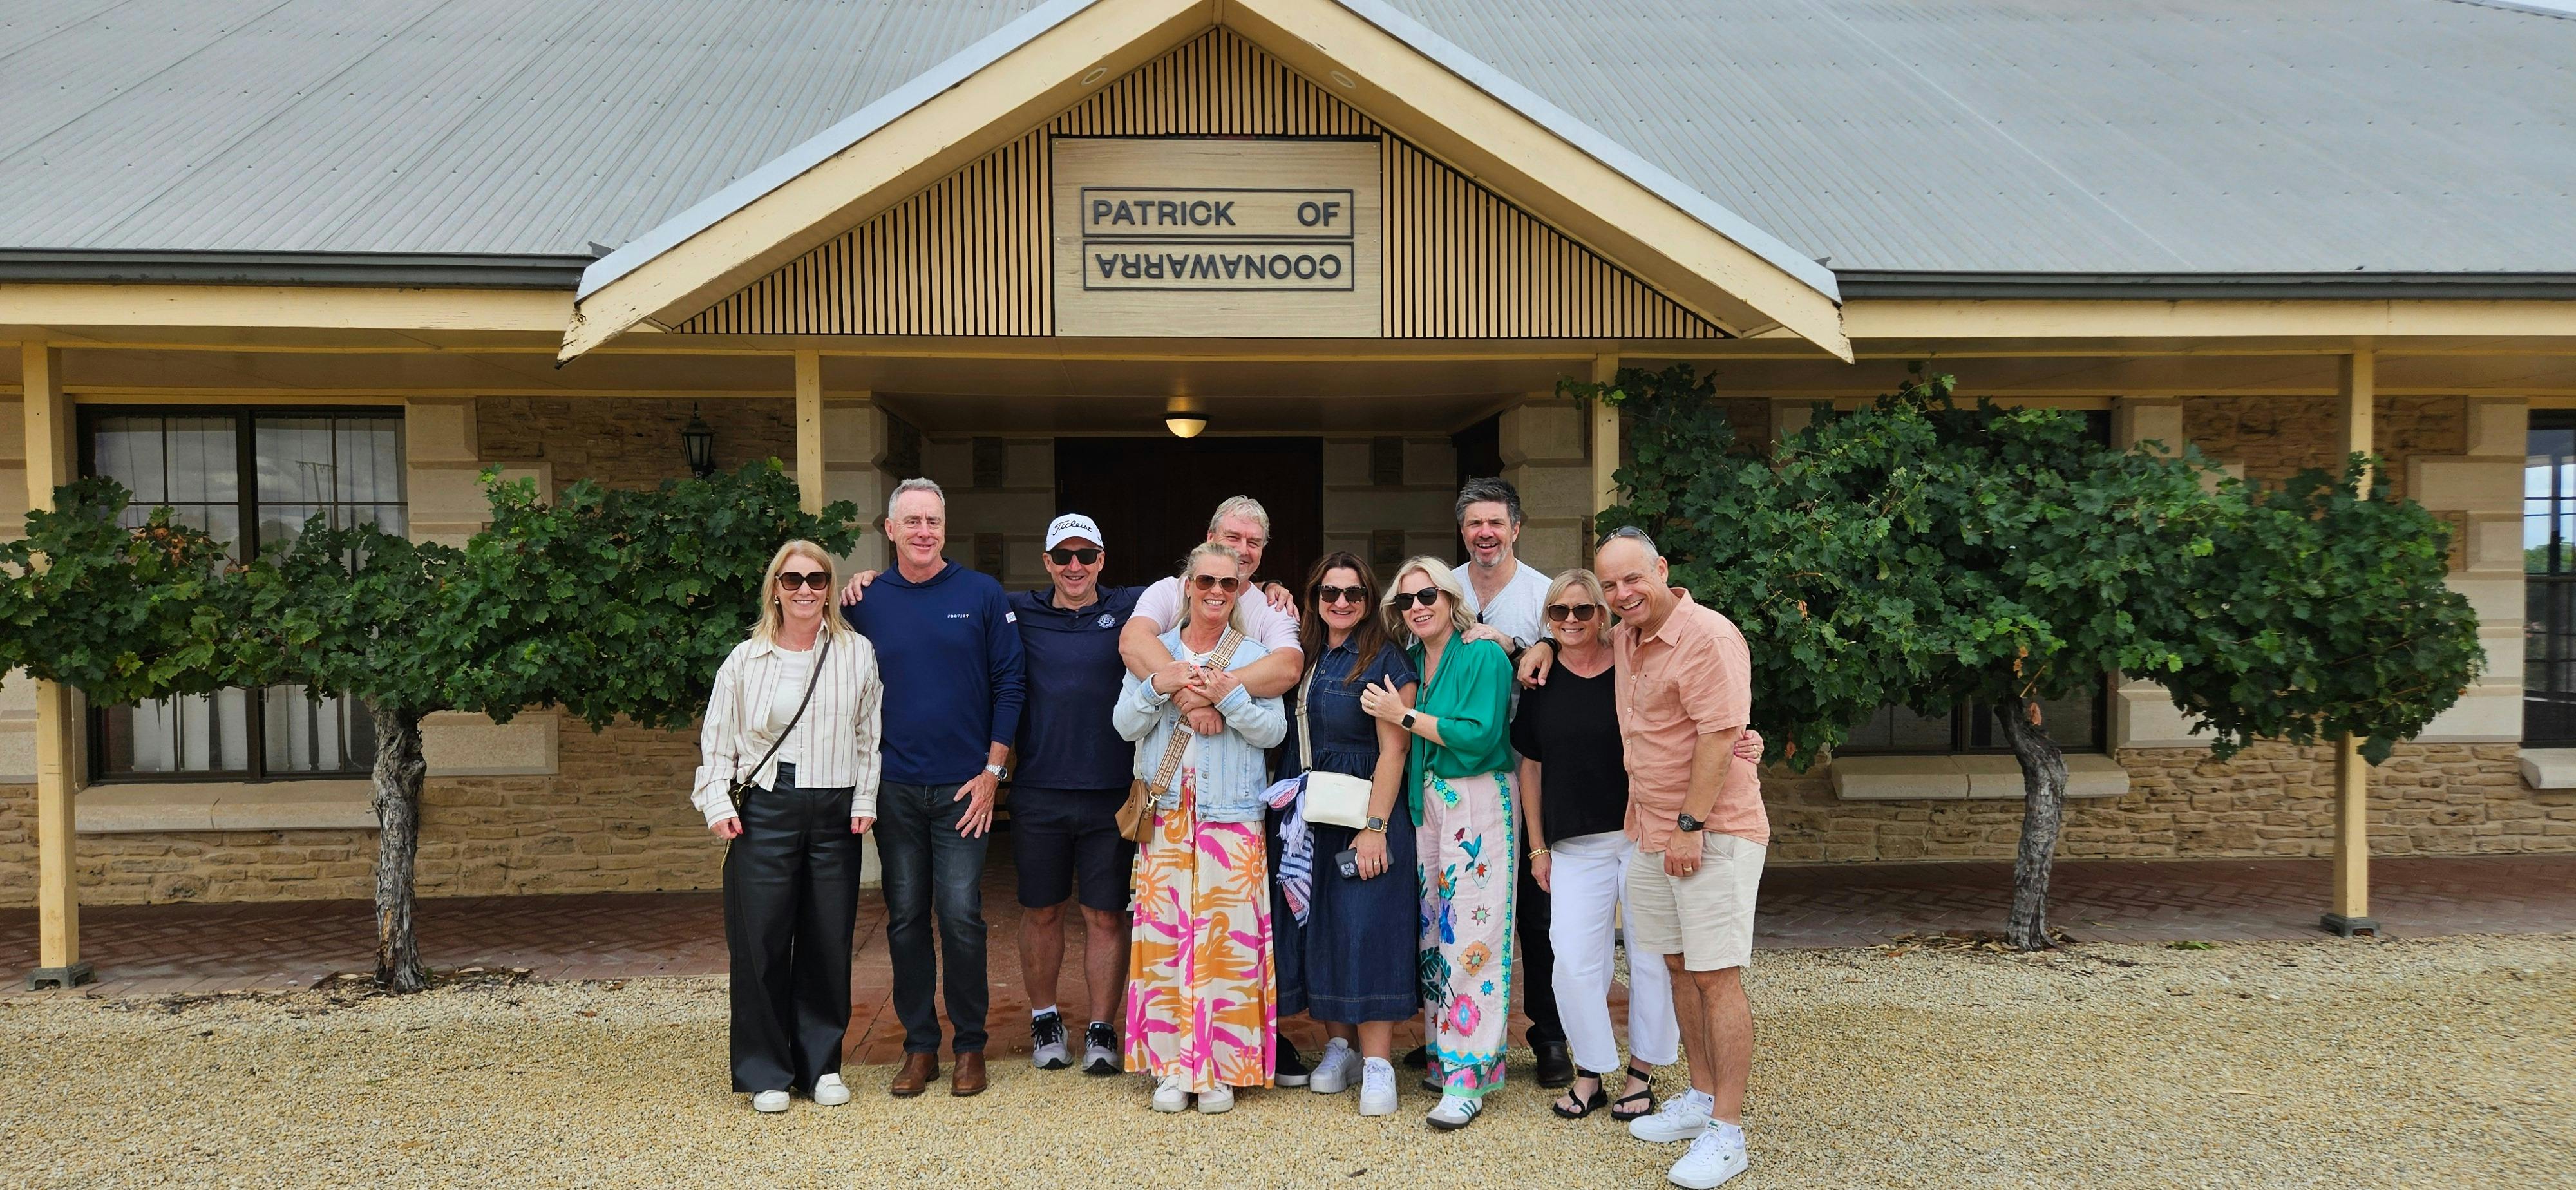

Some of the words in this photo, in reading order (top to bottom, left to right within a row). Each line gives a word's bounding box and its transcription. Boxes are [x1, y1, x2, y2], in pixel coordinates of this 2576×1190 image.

[1093, 200, 1236, 227] PATRICK
[1297, 201, 1340, 227] OF
[1095, 254, 1341, 279] COONAWARRA
[1052, 520, 1093, 536] Titleist
